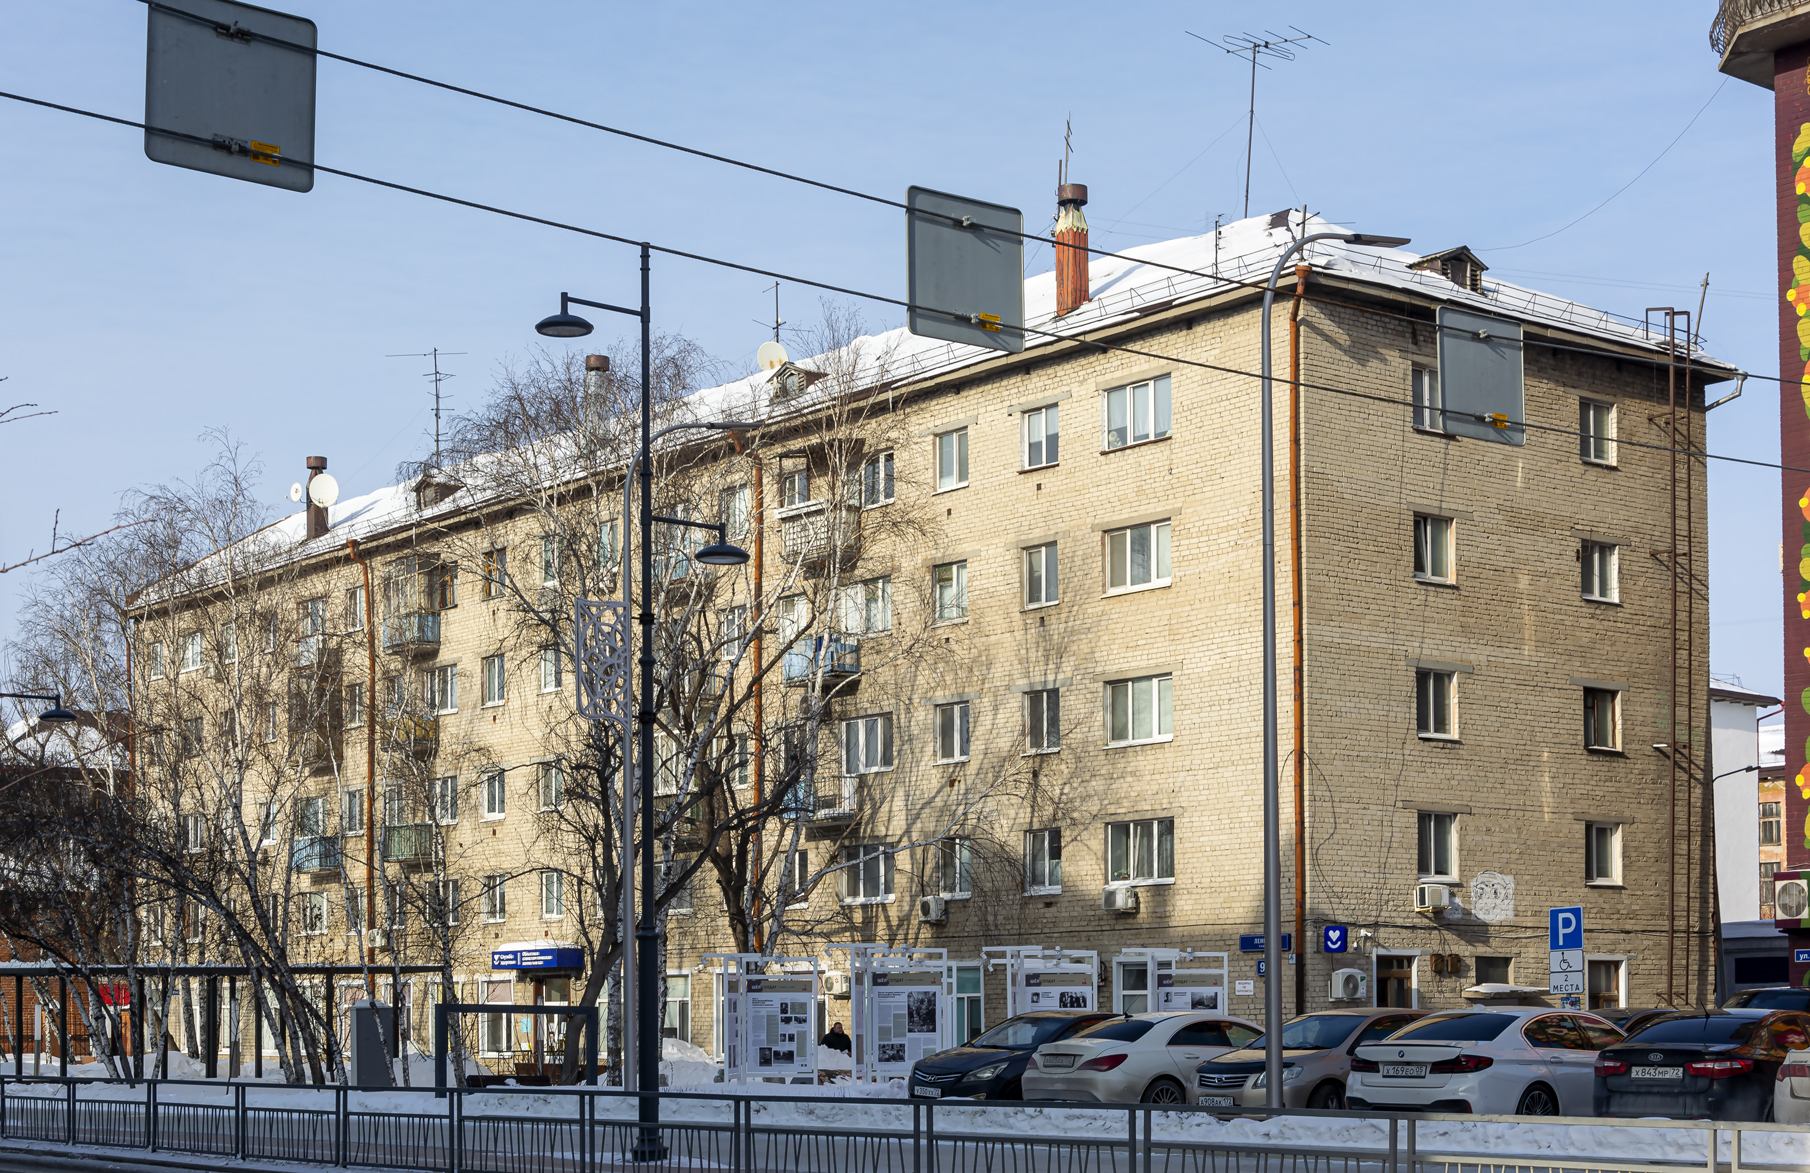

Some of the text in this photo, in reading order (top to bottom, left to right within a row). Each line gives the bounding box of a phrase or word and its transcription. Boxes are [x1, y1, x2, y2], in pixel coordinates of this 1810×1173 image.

[1558, 912, 1576, 946] P
[1564, 974, 1569, 982] 2
[1552, 984, 1580, 992] МЕСТА
